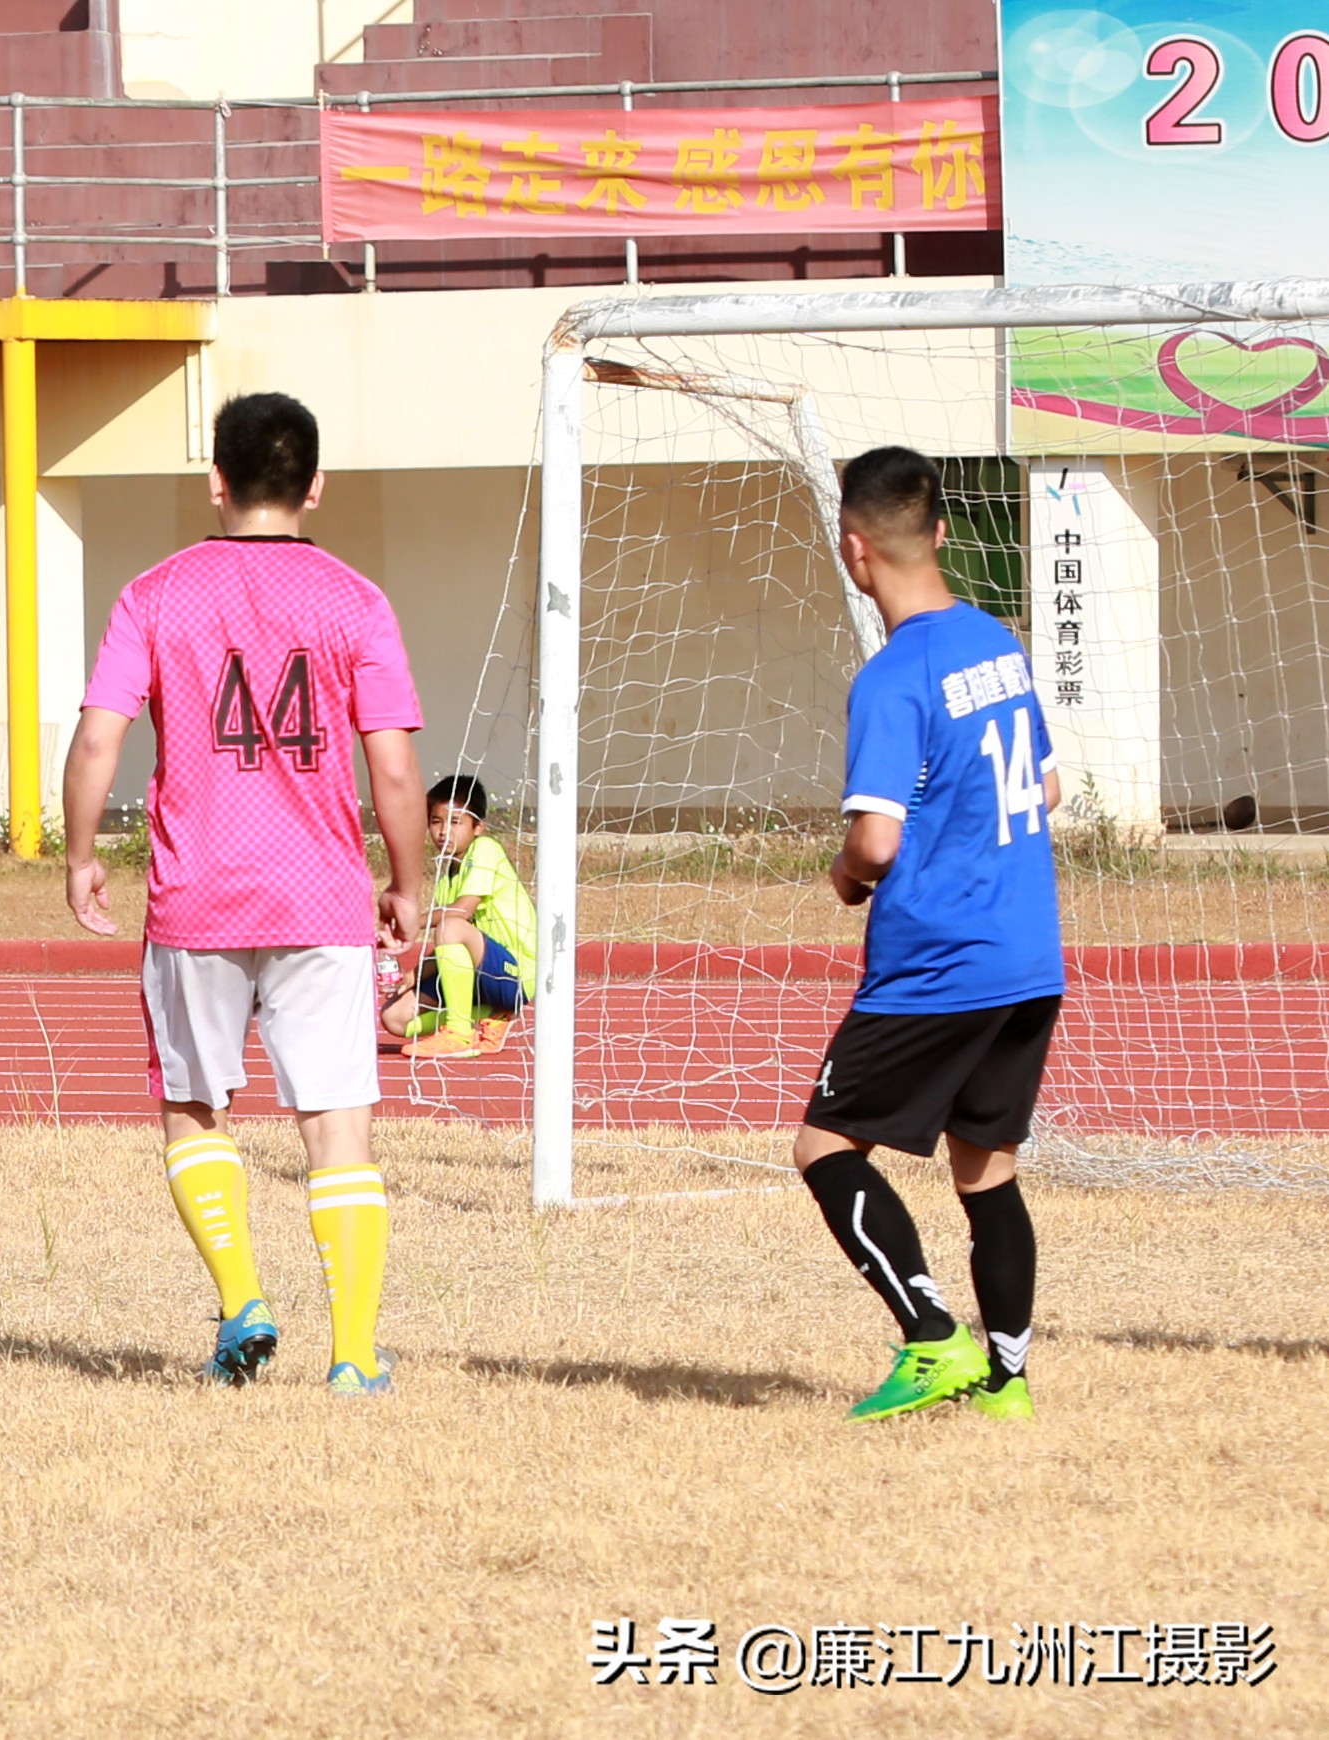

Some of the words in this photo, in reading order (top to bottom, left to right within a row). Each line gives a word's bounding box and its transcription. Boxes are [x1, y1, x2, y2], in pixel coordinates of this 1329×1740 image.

[340, 131, 647, 217] 一路走来
[671, 119, 986, 215] 感恩有你
[1053, 528, 1084, 706] 中国体育彩票
[211, 647, 327, 772] 44
[980, 706, 1045, 847] 14
[196, 1190, 234, 1251] NIKE
[914, 1357, 954, 1395] adidas
